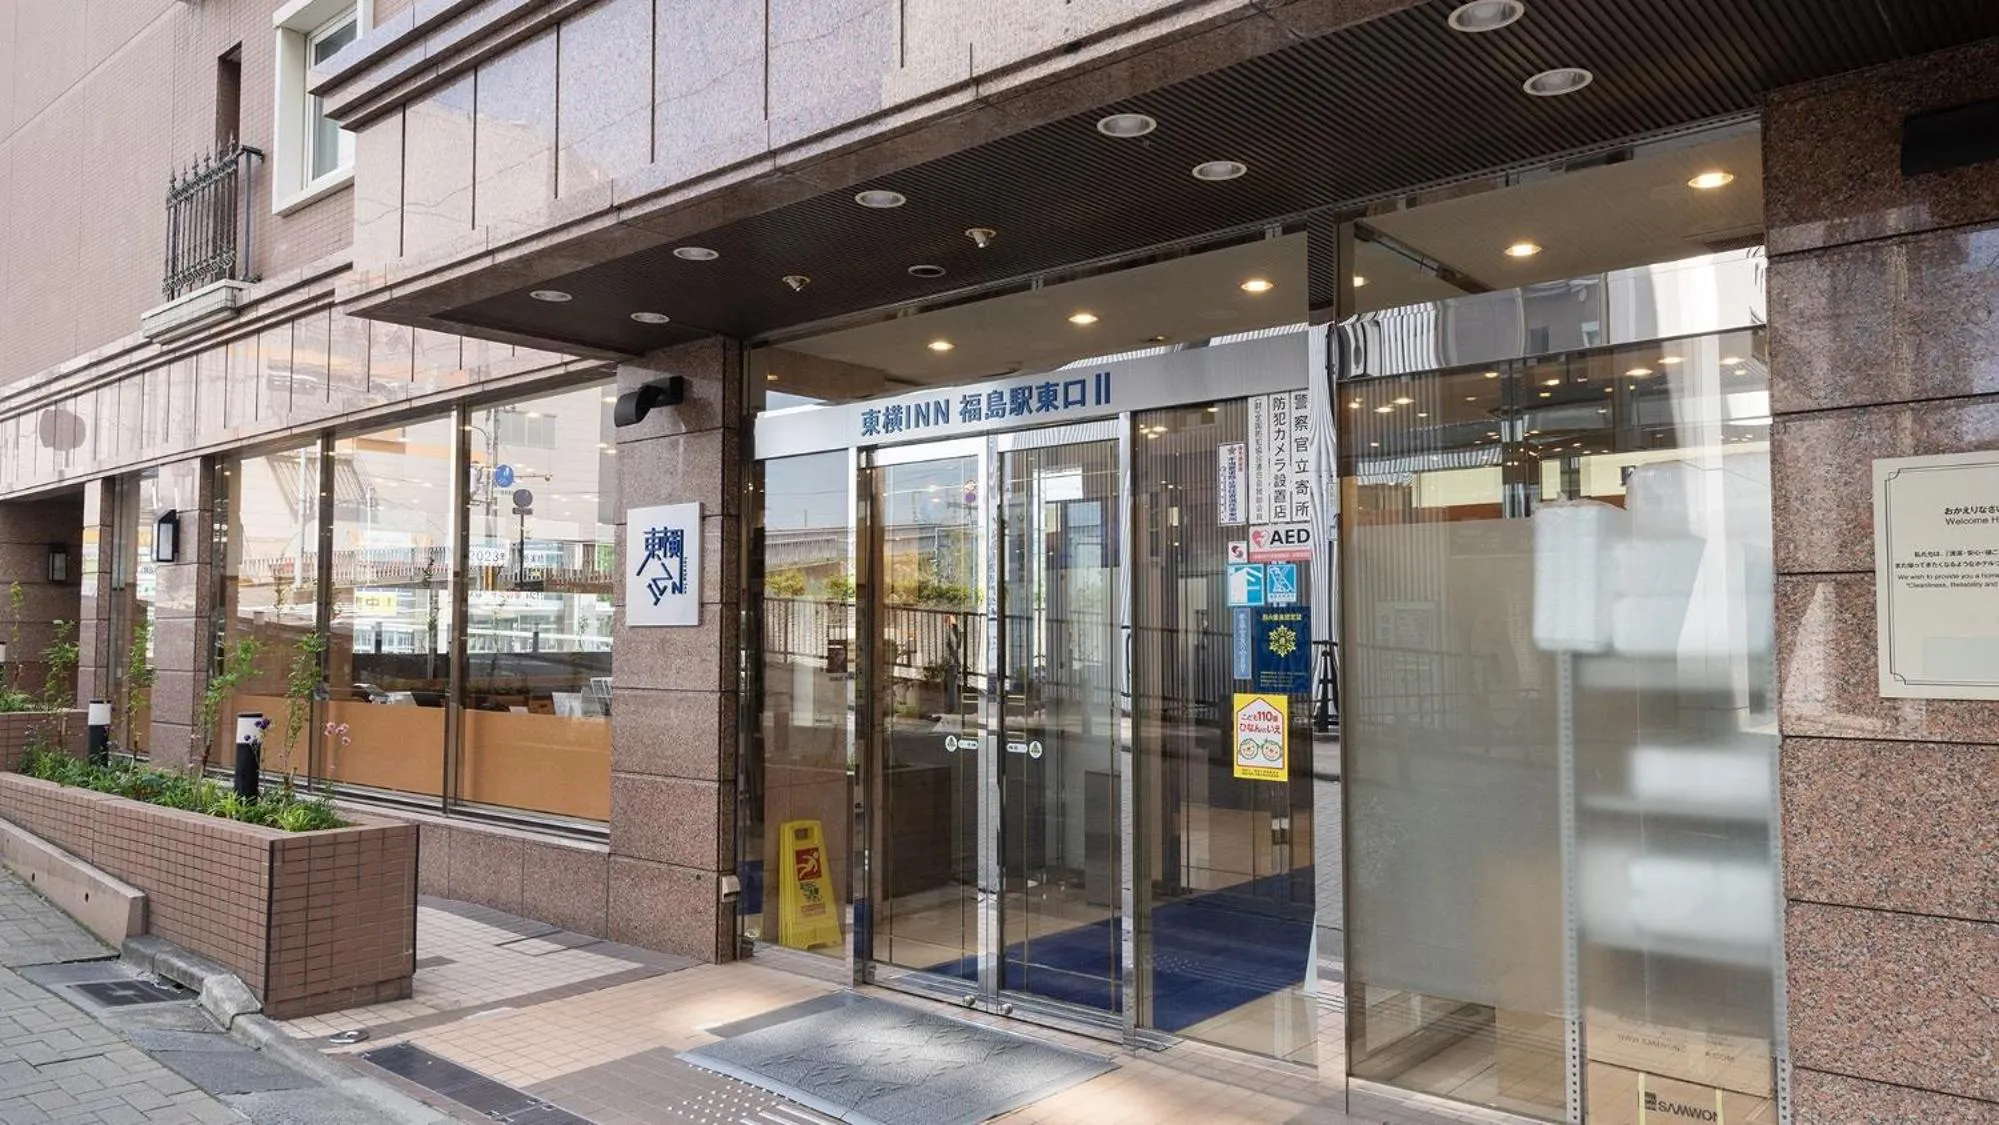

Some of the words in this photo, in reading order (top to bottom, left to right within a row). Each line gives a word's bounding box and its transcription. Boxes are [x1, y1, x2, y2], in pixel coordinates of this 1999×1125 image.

[861, 399, 950, 437] 東横INN
[1273, 396, 1287, 519] 防犯カメラ設置店
[1294, 393, 1310, 517] 警察官立寄所
[1270, 529, 1310, 545] AED
[1945, 517, 1989, 526] Welcome
